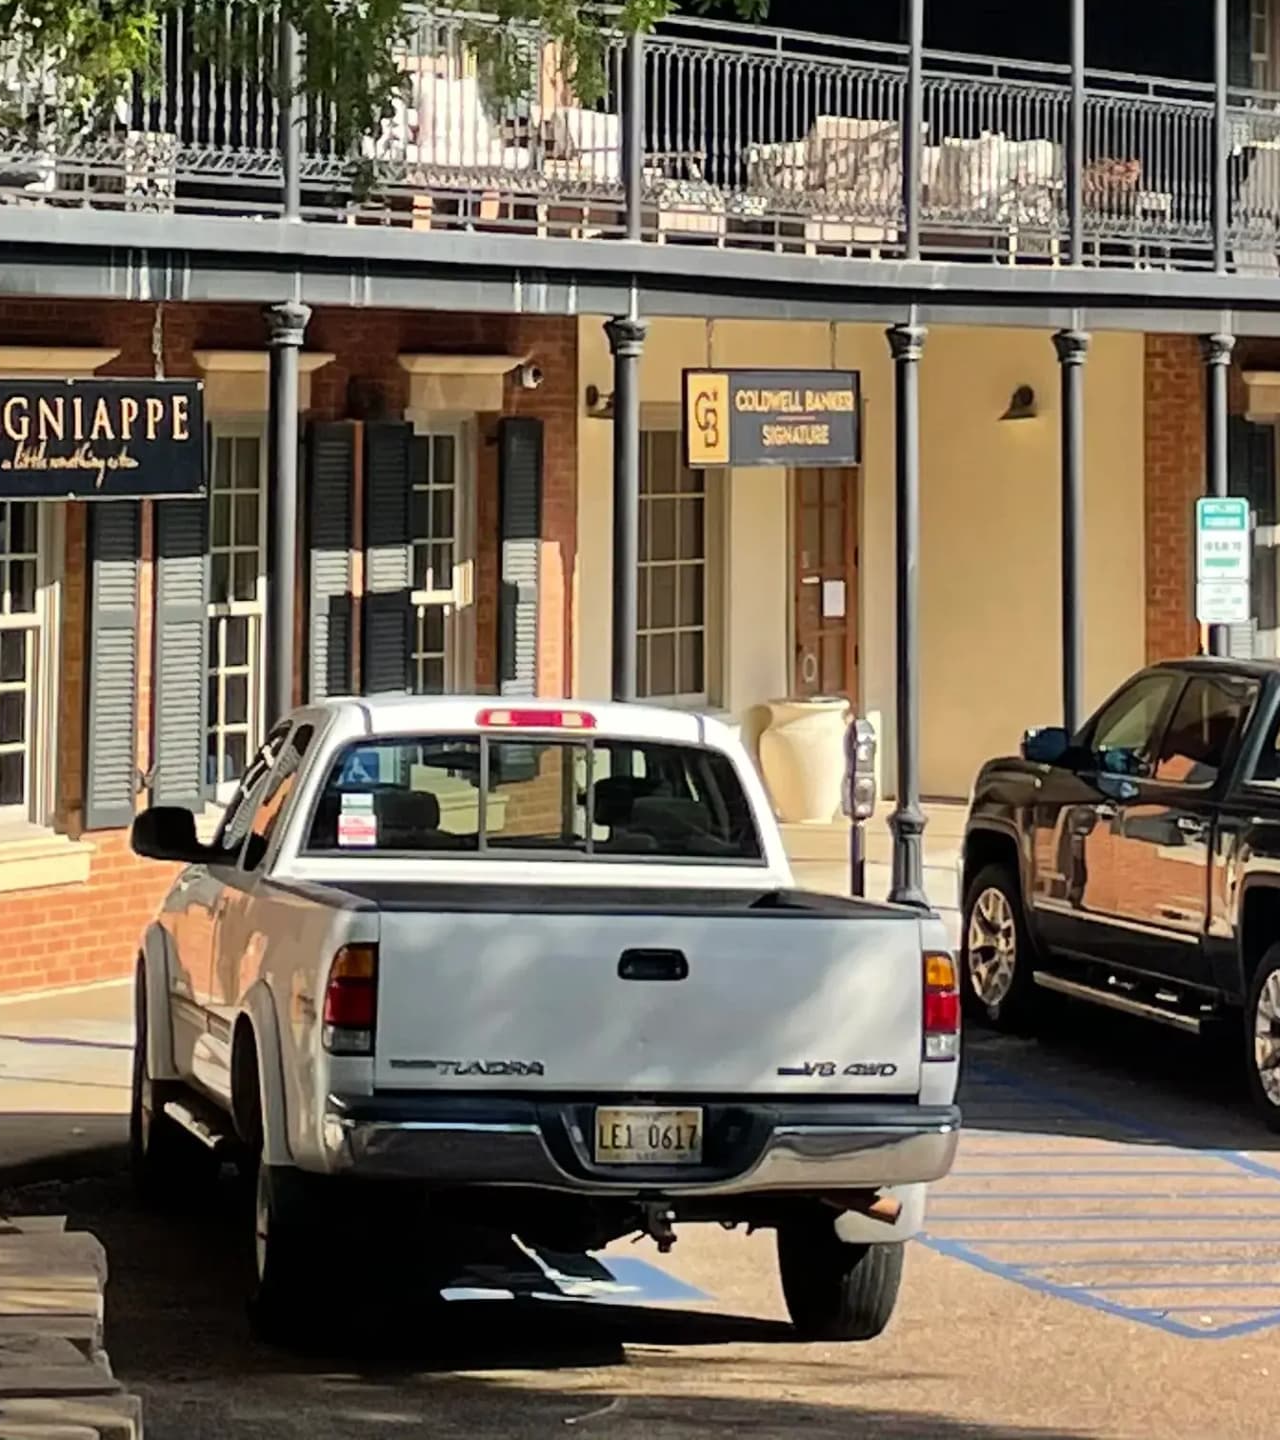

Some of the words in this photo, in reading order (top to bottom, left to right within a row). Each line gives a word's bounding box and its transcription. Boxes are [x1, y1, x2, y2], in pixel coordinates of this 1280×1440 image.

[735, 389, 803, 412] COLDWELL
[805, 389, 855, 412] BANKER
[762, 424, 830, 446] SIGNATURE
[842, 1062, 898, 1078] 4WD
[599, 1123, 634, 1150] LE1
[647, 1123, 698, 1151] 0617
